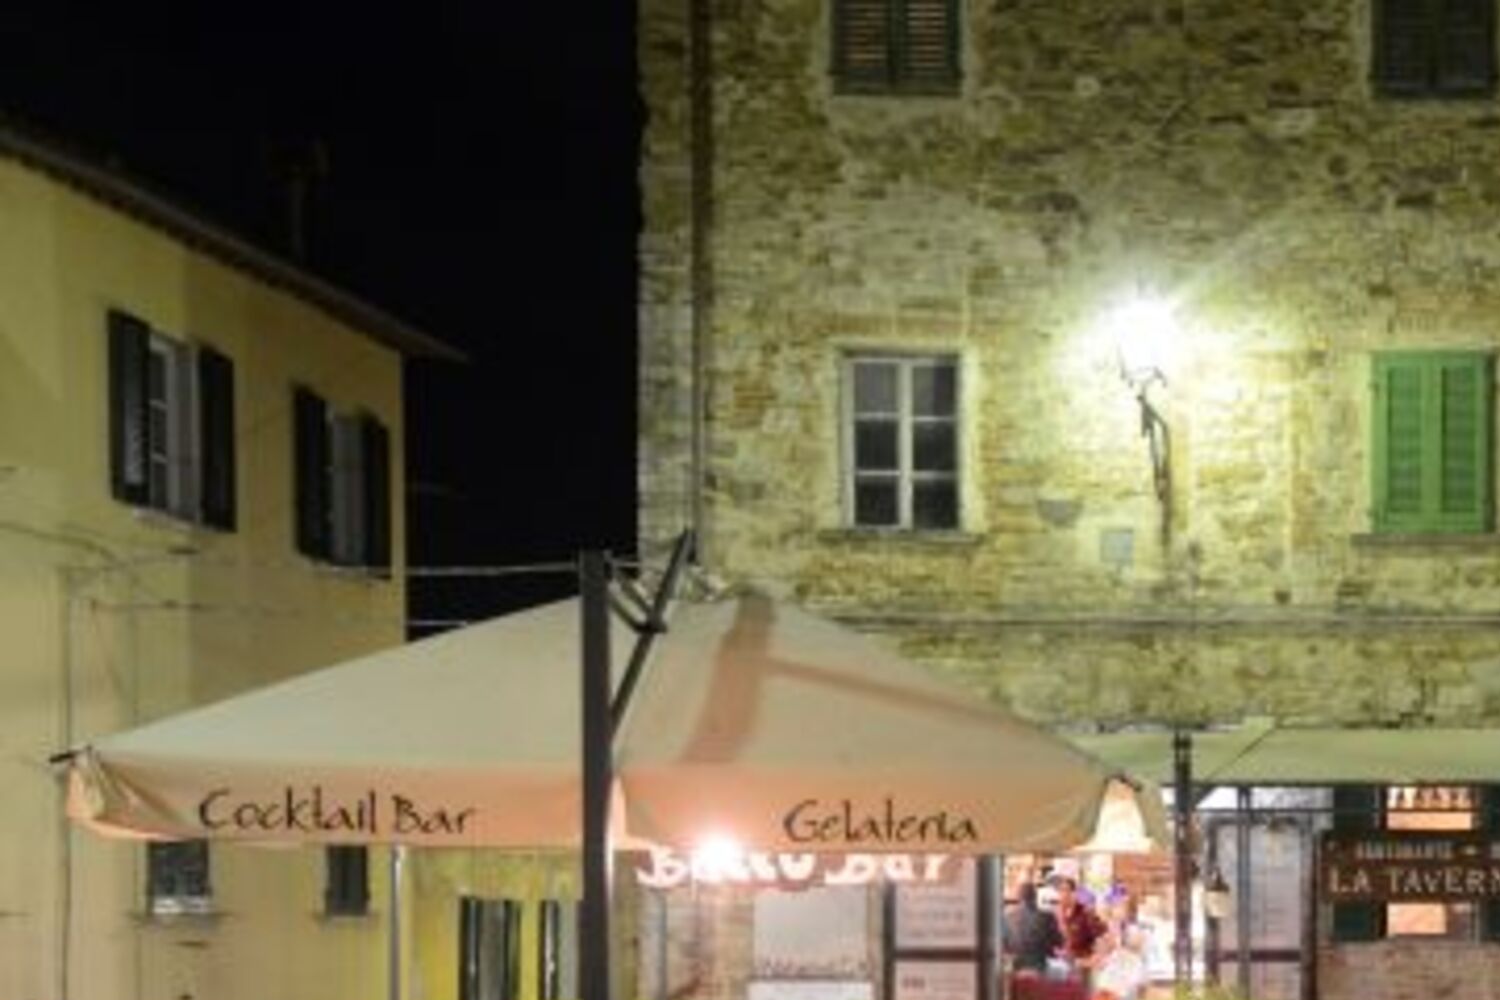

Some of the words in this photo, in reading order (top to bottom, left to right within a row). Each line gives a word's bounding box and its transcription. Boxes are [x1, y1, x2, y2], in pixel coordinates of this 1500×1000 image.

[199, 785, 376, 834] Cocktail
[391, 794, 479, 834] Bar
[783, 796, 978, 843] Gelateria
[1330, 866, 1372, 893] LA
